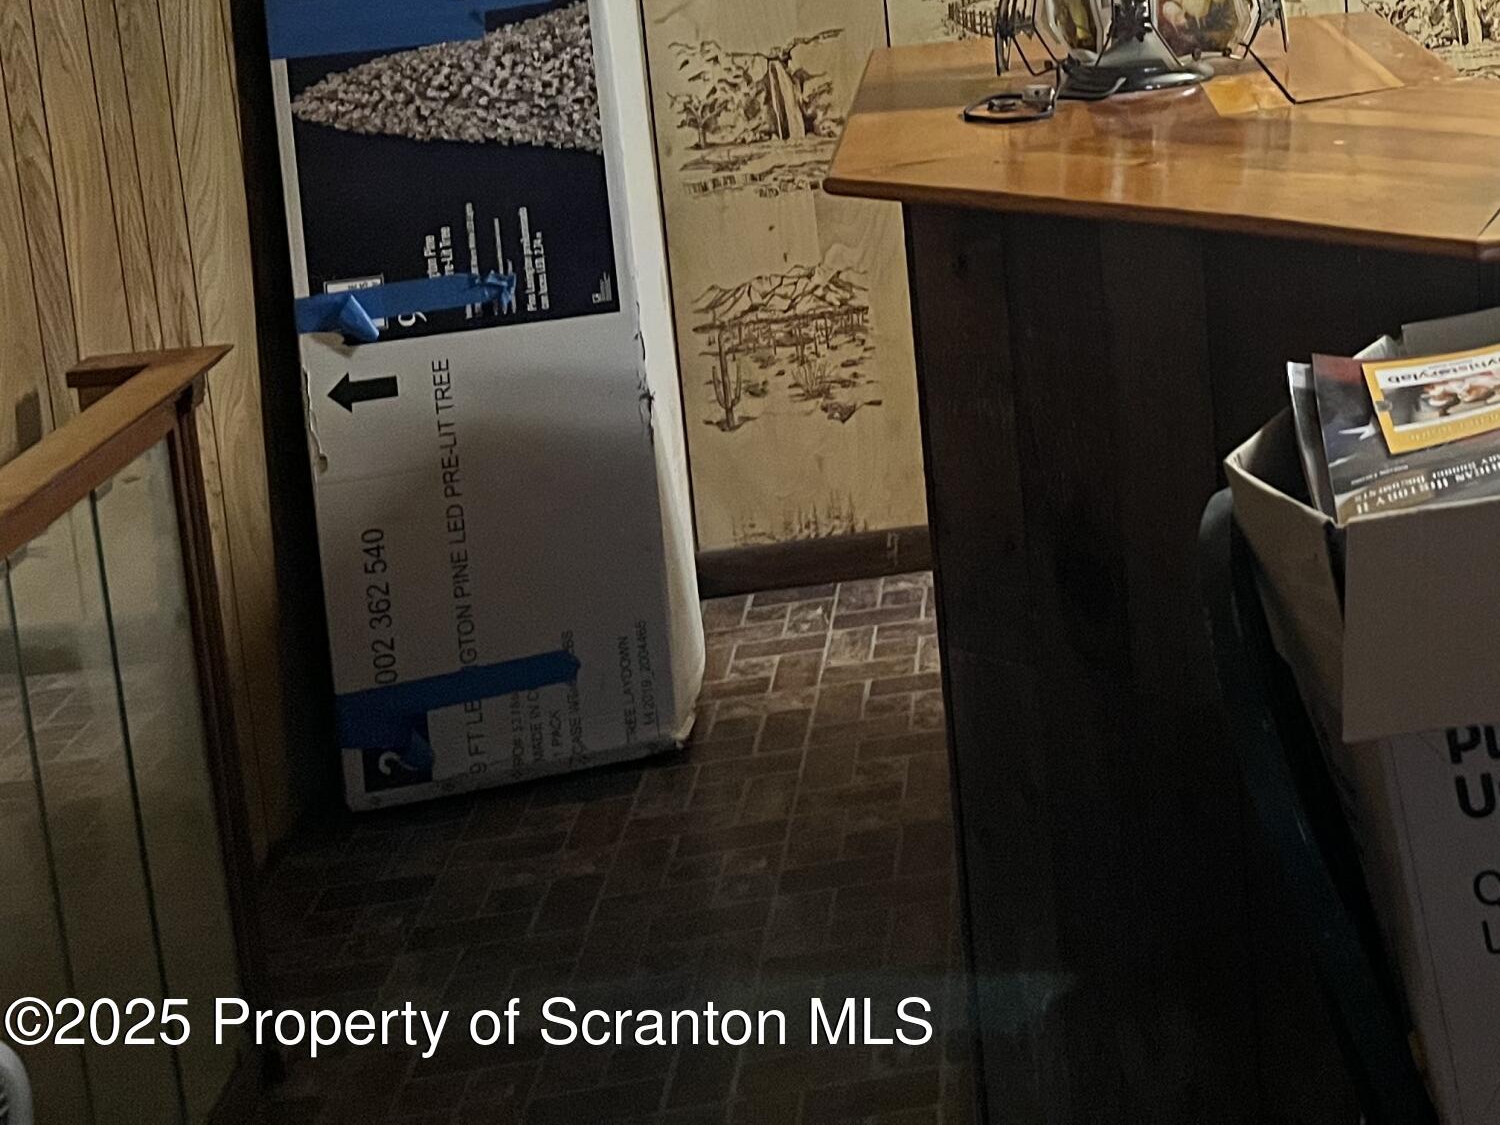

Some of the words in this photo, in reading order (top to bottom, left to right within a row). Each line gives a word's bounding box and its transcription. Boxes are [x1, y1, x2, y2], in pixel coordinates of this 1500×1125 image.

[431, 358, 453, 413] TREE
[437, 419, 462, 497] PRE-LIT
[445, 504, 467, 544] LED
[361, 529, 387, 573] 540
[450, 548, 472, 598] PINE
[366, 583, 392, 629] 362
[467, 731, 487, 756] FT
